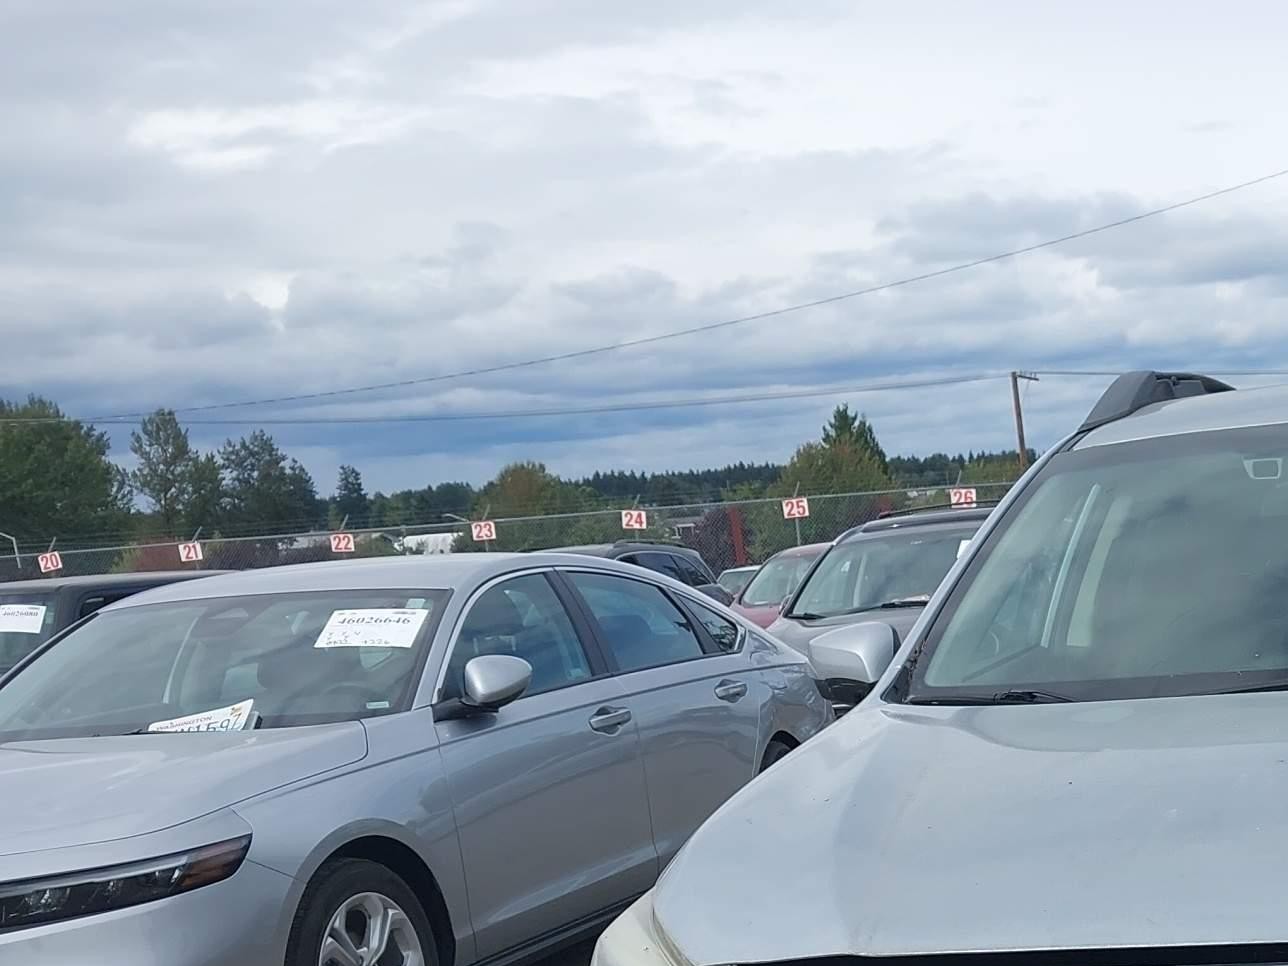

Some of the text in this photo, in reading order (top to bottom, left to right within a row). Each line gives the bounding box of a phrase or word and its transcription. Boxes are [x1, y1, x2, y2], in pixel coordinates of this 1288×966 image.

[785, 499, 807, 517] 25
[624, 511, 645, 528] 24
[474, 522, 494, 539] 23
[333, 535, 352, 551] 22
[183, 544, 200, 560] 21
[41, 553, 60, 570] 20
